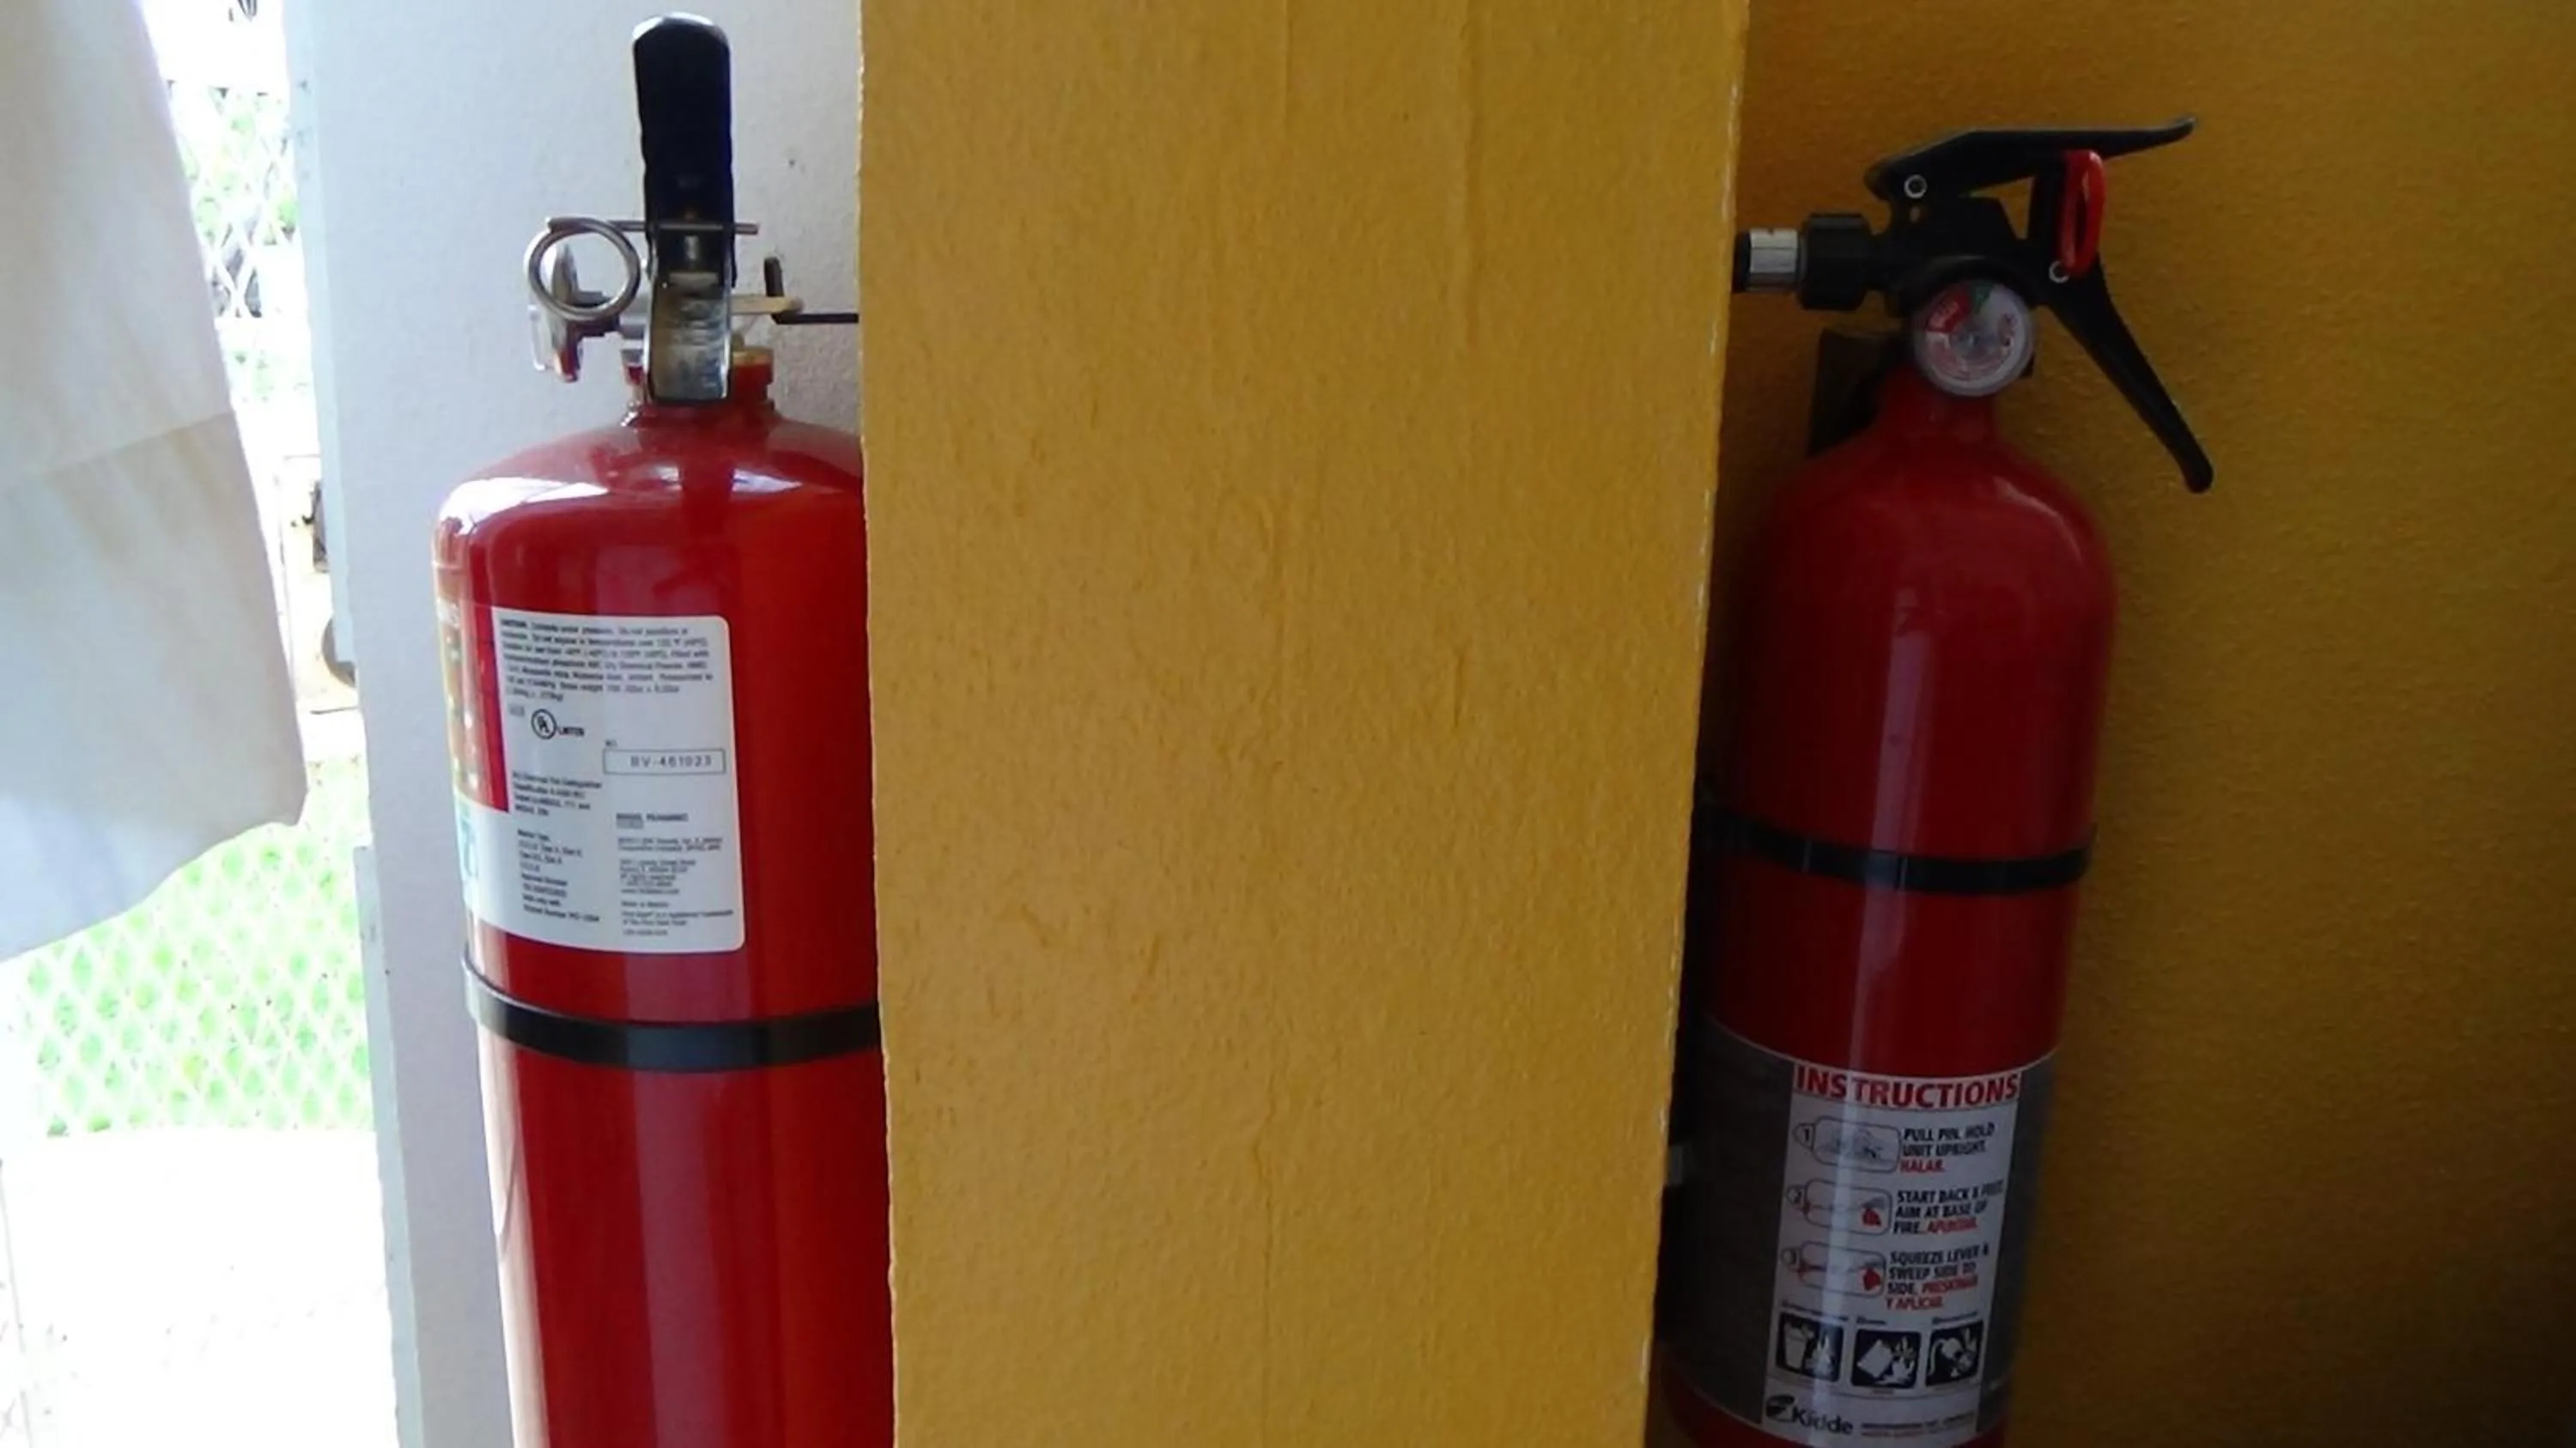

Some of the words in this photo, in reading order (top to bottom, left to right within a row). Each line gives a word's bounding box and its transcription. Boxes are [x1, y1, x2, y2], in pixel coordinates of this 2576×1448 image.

[1797, 1066, 2019, 1108] INSTRUCTIONS
[1903, 1127, 1935, 1141] PULL
[1965, 1123, 1995, 1138] HOLD
[1902, 1144, 1931, 1157] UNIT
[1897, 1189, 1935, 1204] START
[1940, 1187, 1969, 1203] BACK
[1895, 1205, 1921, 1219] AIM
[1925, 1204, 1938, 1218] AT
[1943, 1202, 1971, 1217] BASE
[1974, 1200, 1988, 1215] OF
[1890, 1250, 1943, 1265] SQUEEZE
[1947, 1244, 1979, 1262] LEVER
[1889, 1266, 1930, 1280] SWEEP
[1934, 1264, 1958, 1278] SIDE
[1963, 1262, 1977, 1275] TO
[1886, 1298, 1893, 1310] Y
[1791, 1403, 1853, 1434] Kidde
